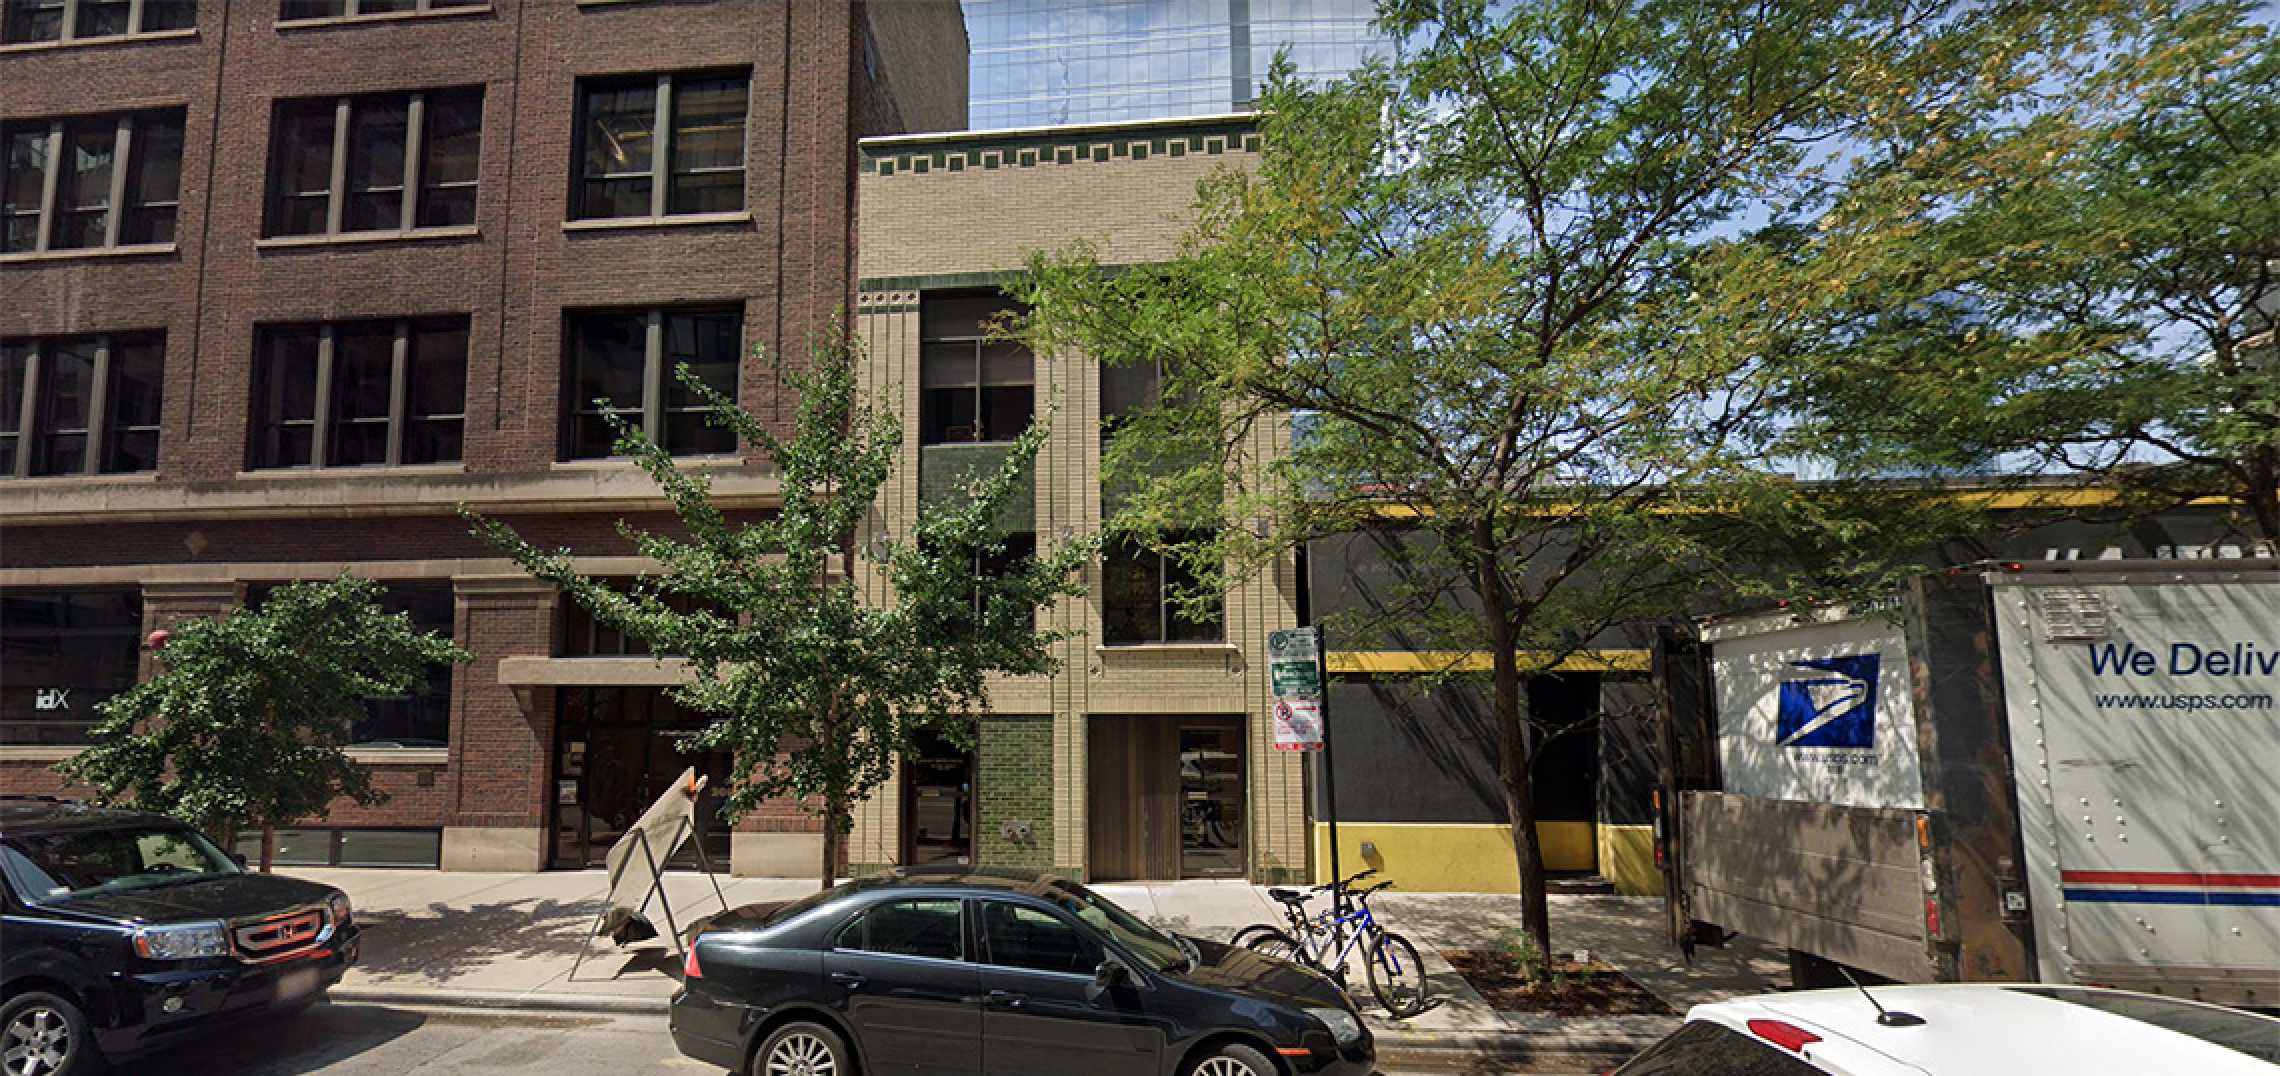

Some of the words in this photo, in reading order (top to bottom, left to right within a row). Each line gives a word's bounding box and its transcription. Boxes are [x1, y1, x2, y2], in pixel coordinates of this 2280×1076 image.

[2089, 642, 2156, 676] We
[2171, 642, 2280, 676] Deliv
[2096, 695, 2272, 712] www.usps.com
